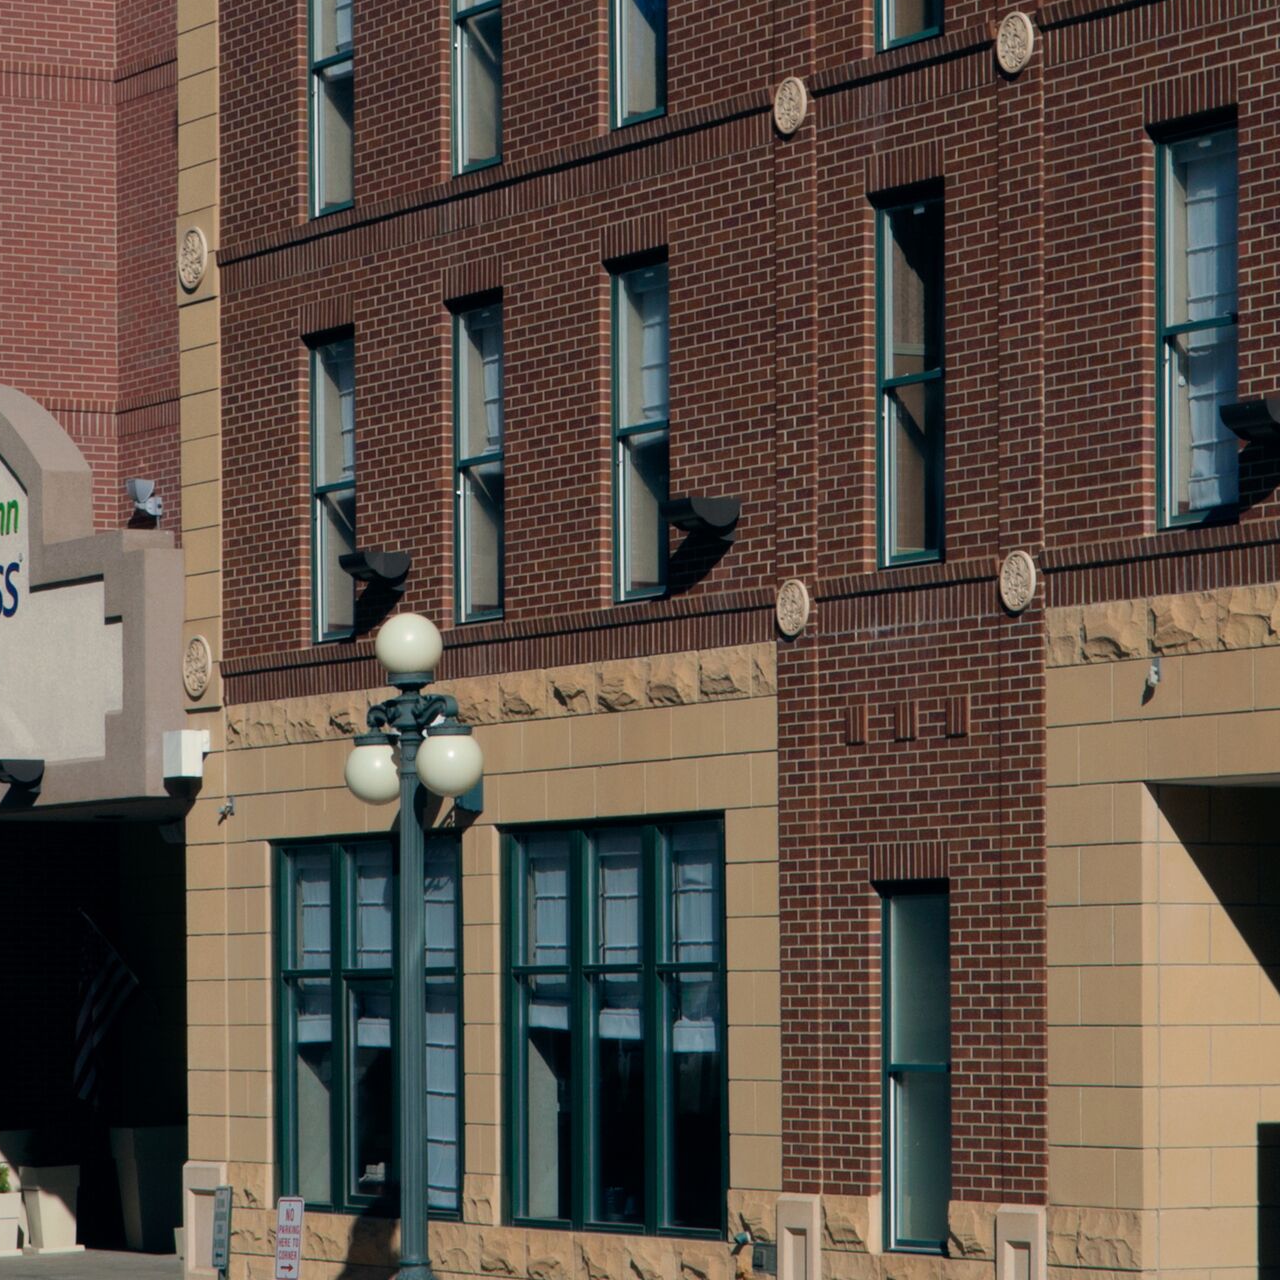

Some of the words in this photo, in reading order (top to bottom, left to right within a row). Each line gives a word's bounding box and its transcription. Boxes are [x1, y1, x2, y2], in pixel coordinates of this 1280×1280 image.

[286, 1208, 294, 1221] NO
[278, 1225, 300, 1234] PARKING
[278, 1238, 290, 1247] HERE
[293, 1238, 299, 1247] TO
[278, 1250, 297, 1260] CORNER
